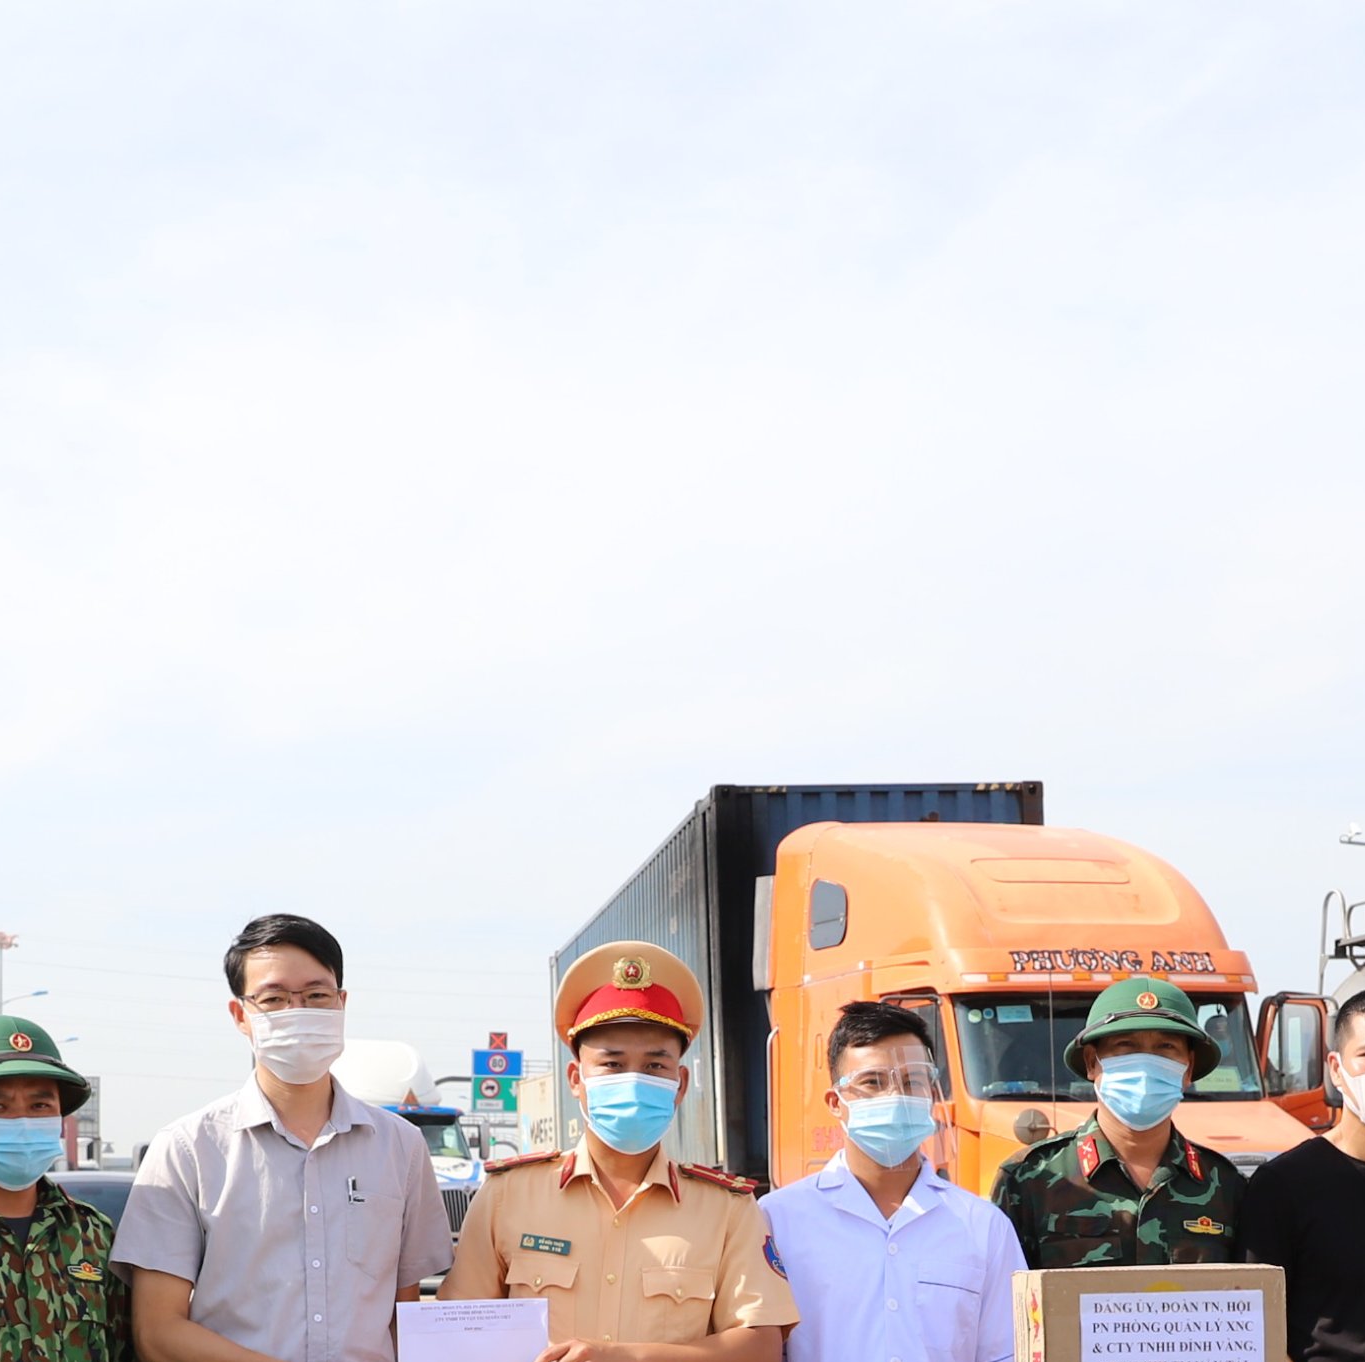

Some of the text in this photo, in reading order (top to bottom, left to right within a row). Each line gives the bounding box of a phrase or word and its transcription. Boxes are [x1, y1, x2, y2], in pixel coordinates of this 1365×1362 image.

[1151, 951, 1216, 973] ANH
[1093, 1298, 1251, 1315] ĐẢNG ỦY, ĐOÀN TN, HỘI
[1091, 1317, 1251, 1336] PN PHÒNG QUẢN LÝ XNC
[1091, 1337, 1257, 1354] & CTY TNHH ĐỈNH VÀNG,
